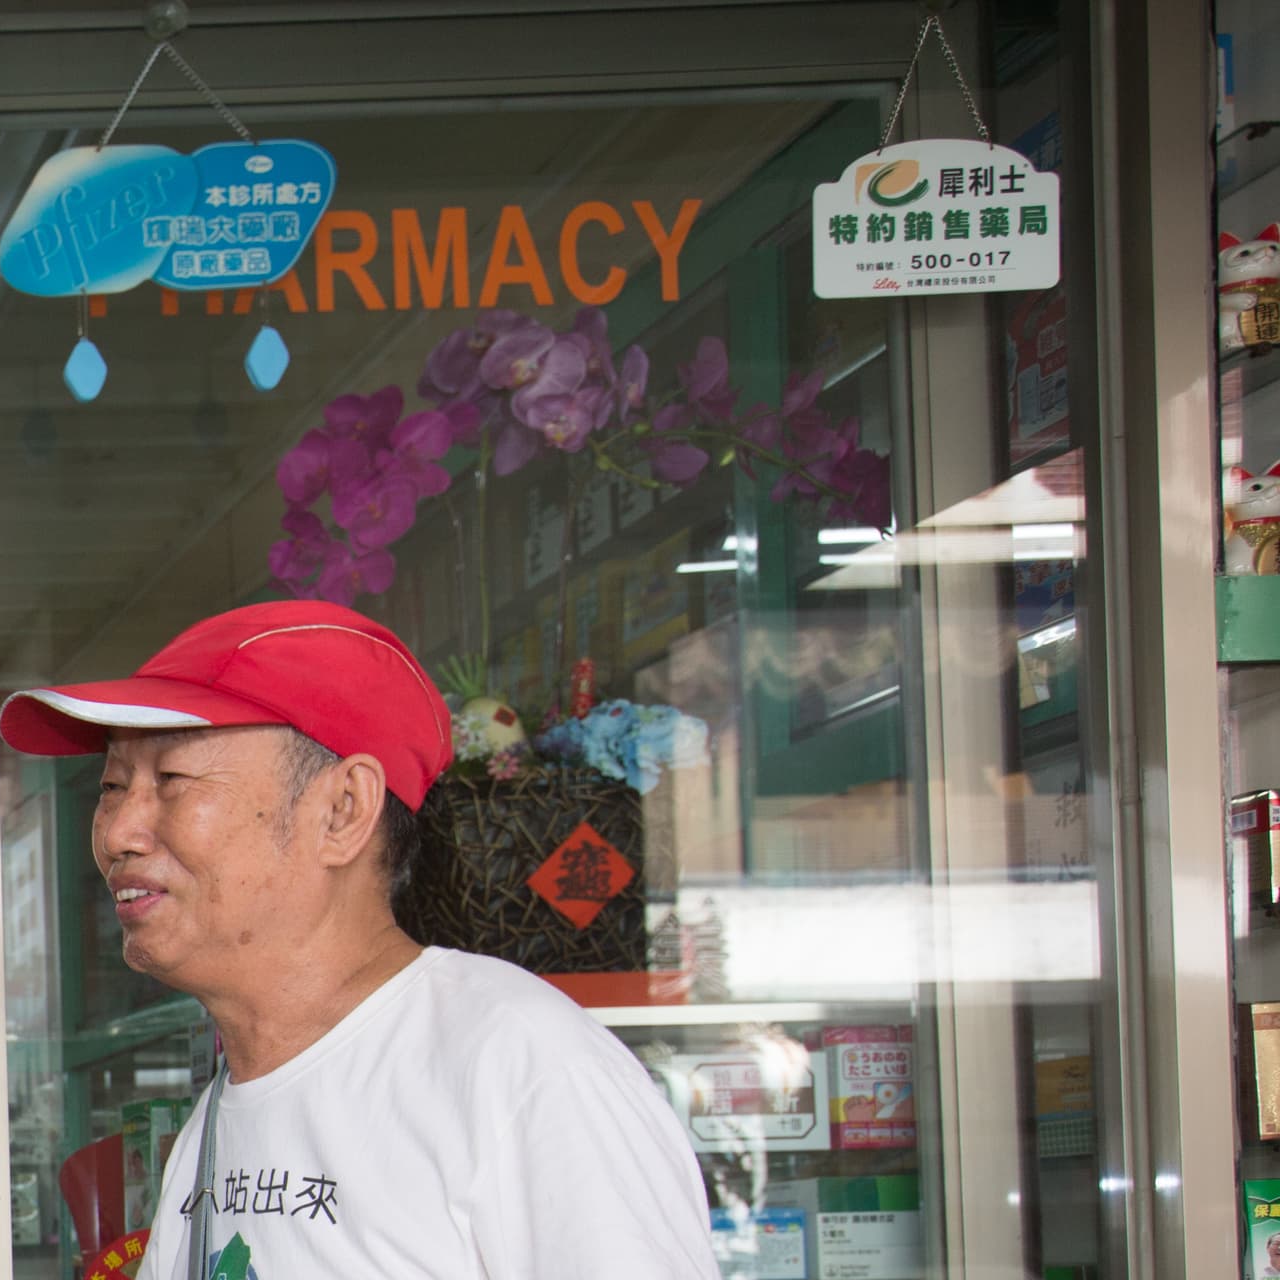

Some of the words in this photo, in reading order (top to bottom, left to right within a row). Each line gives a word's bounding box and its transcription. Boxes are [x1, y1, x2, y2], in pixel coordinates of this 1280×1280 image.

[205, 181, 322, 208] 本診所處方
[939, 165, 1026, 198] 犀利士
[143, 214, 300, 248] 輝瑞大藥廠
[828, 204, 1048, 244] 特約銷售藥局
[90, 199, 704, 317] RMACY
[173, 250, 271, 277] 原廠藥品
[910, 250, 1011, 270] 500-017
[873, 277, 903, 291] Lilly
